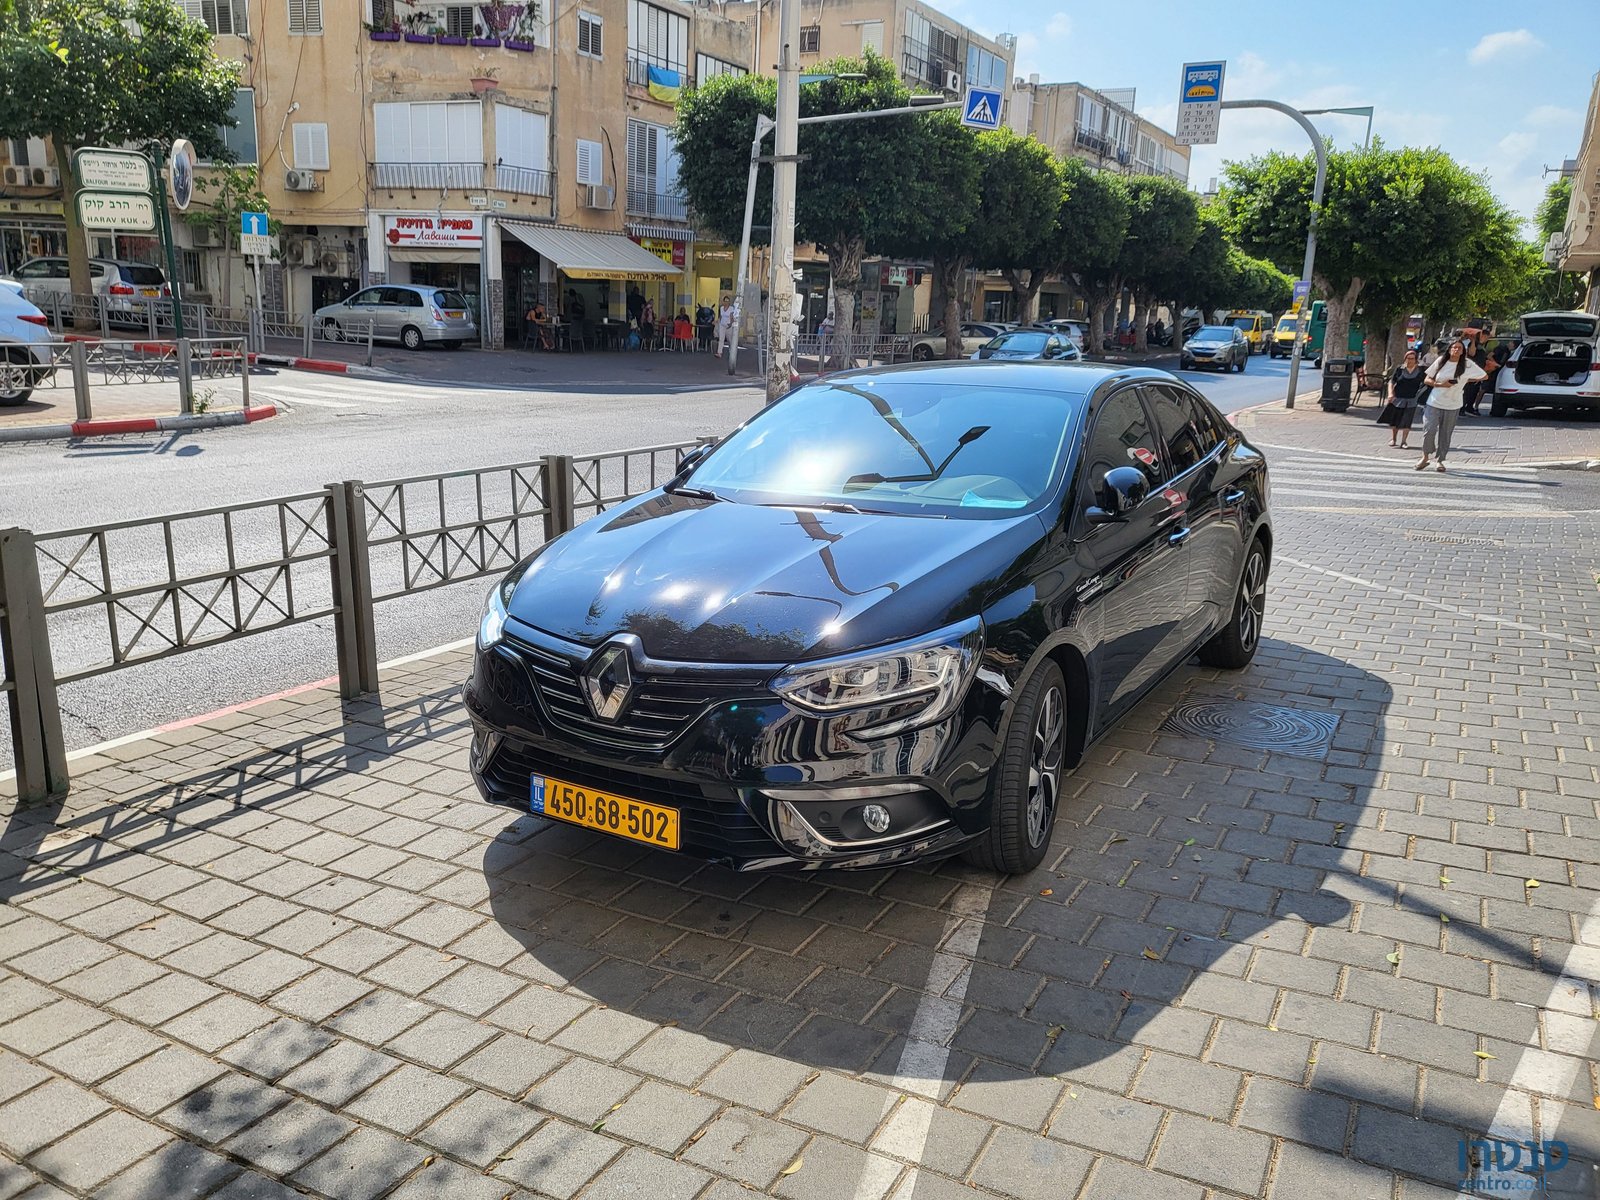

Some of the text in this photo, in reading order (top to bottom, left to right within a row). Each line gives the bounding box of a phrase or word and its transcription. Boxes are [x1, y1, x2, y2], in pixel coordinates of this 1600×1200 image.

[119, 160, 137, 170] בלפור
[85, 178, 109, 186] BALFOUR
[84, 199, 104, 210] קוק
[109, 200, 130, 209] הרב
[416, 230, 455, 241] Лаваши
[534, 785, 543, 801] IL
